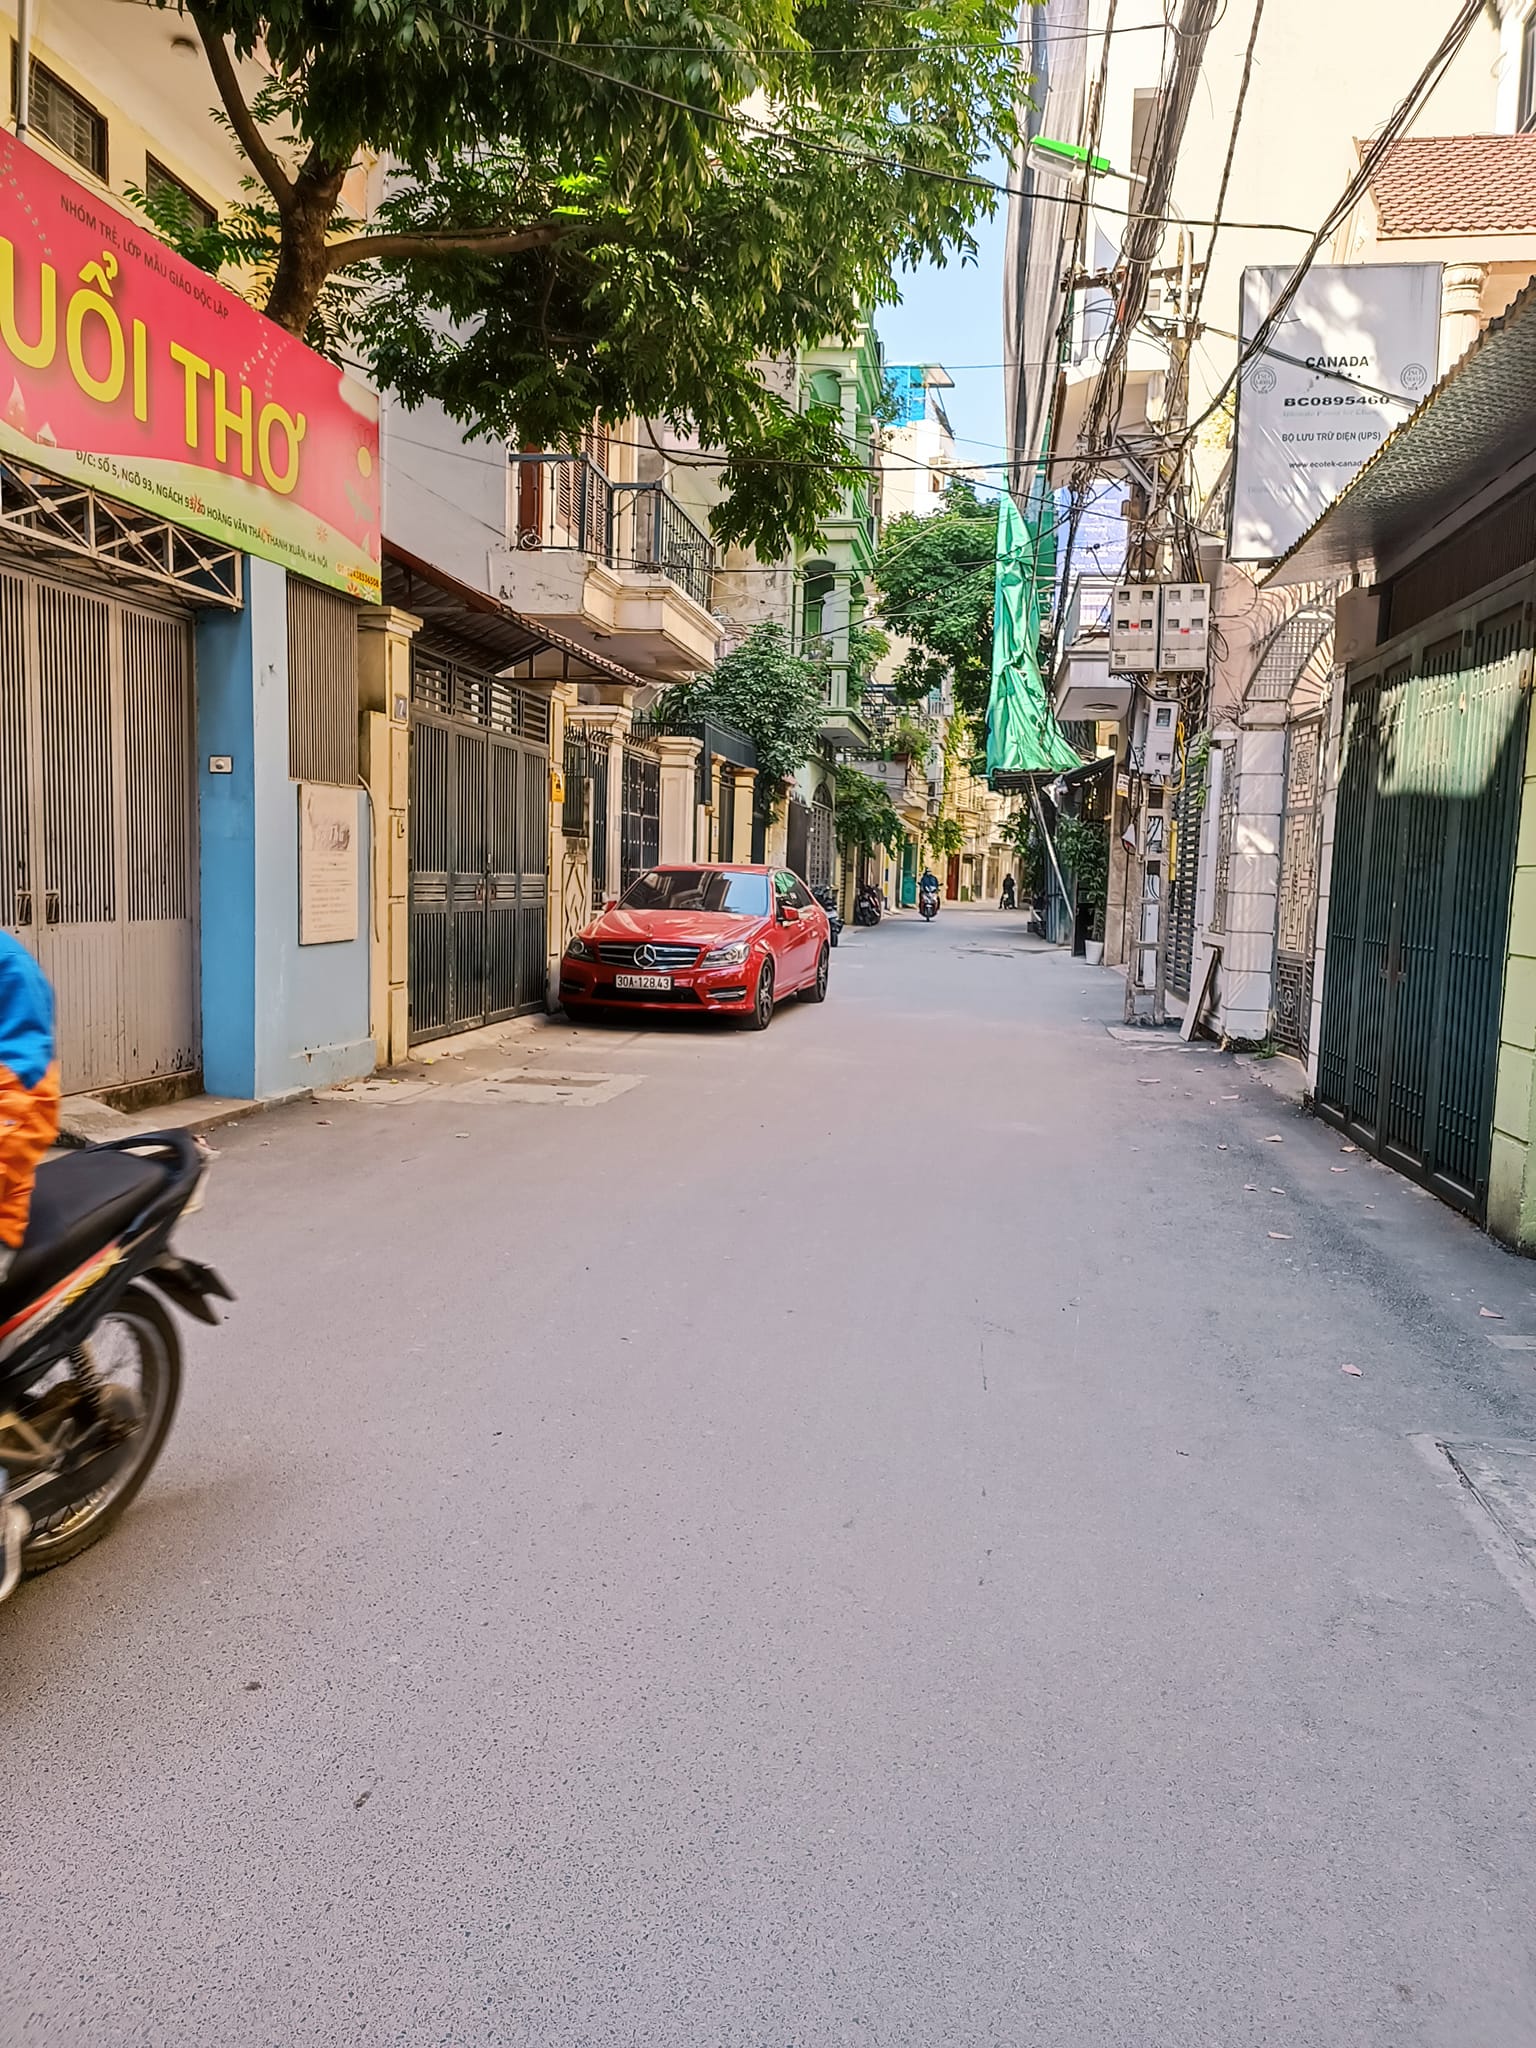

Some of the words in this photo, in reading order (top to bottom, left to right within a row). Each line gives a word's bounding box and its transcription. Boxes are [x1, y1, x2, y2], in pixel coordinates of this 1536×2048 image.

[60, 195, 97, 230] NHÓM
[169, 269, 192, 295] GIÁO
[0, 236, 147, 423] UỔI
[170, 341, 306, 494] THƠ
[1305, 356, 1369, 368] CANADA
[1281, 433, 1295, 443] BỘ
[1296, 432, 1314, 442] LƯU
[1358, 431, 1381, 442] (UPS)
[98, 457, 110, 472] SỐ
[112, 464, 120, 479] 5,
[122, 468, 141, 486] NGÕ
[142, 478, 155, 495] 93,
[156, 484, 183, 504] NGÁCH
[207, 507, 233, 527] HOÀNG
